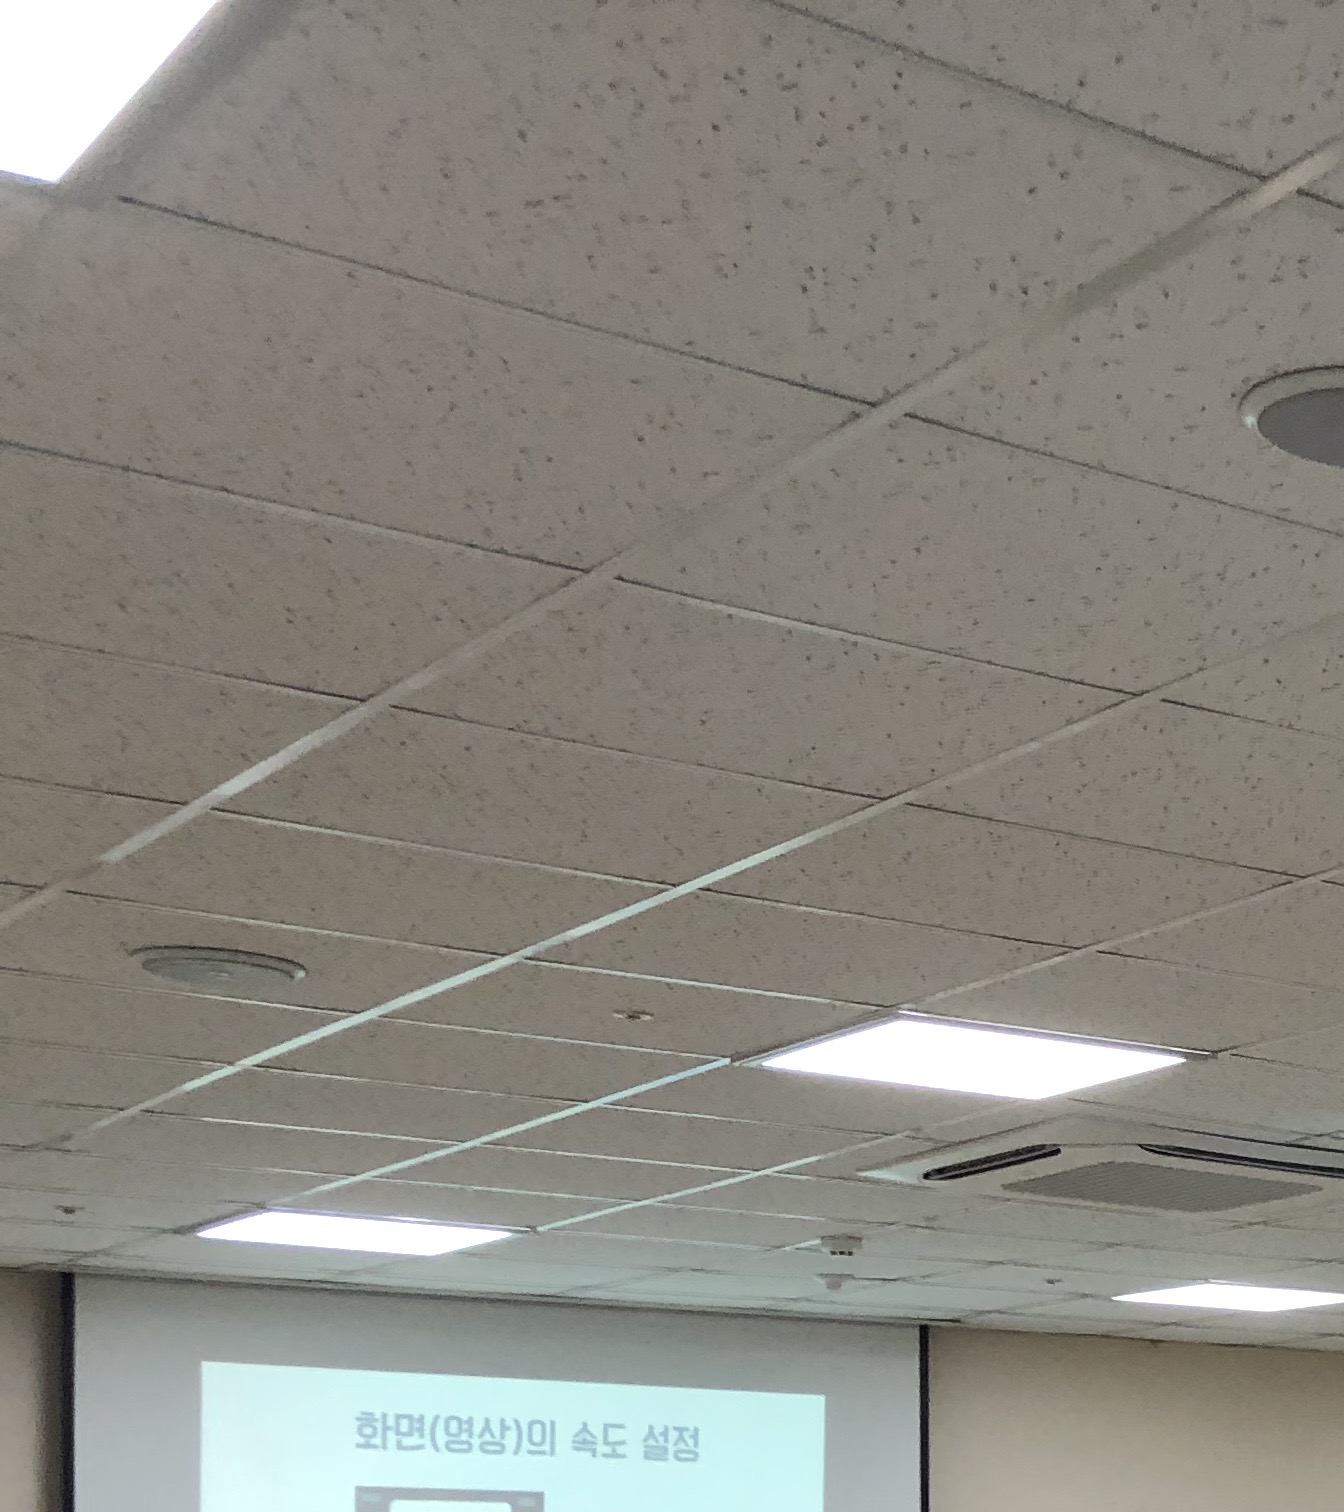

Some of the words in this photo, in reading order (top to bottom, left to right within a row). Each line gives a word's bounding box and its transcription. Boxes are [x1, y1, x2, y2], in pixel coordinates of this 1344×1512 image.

[354, 1410, 557, 1457] 화면(영상)의
[571, 1420, 628, 1459] 속도
[642, 1423, 700, 1462] 설정
